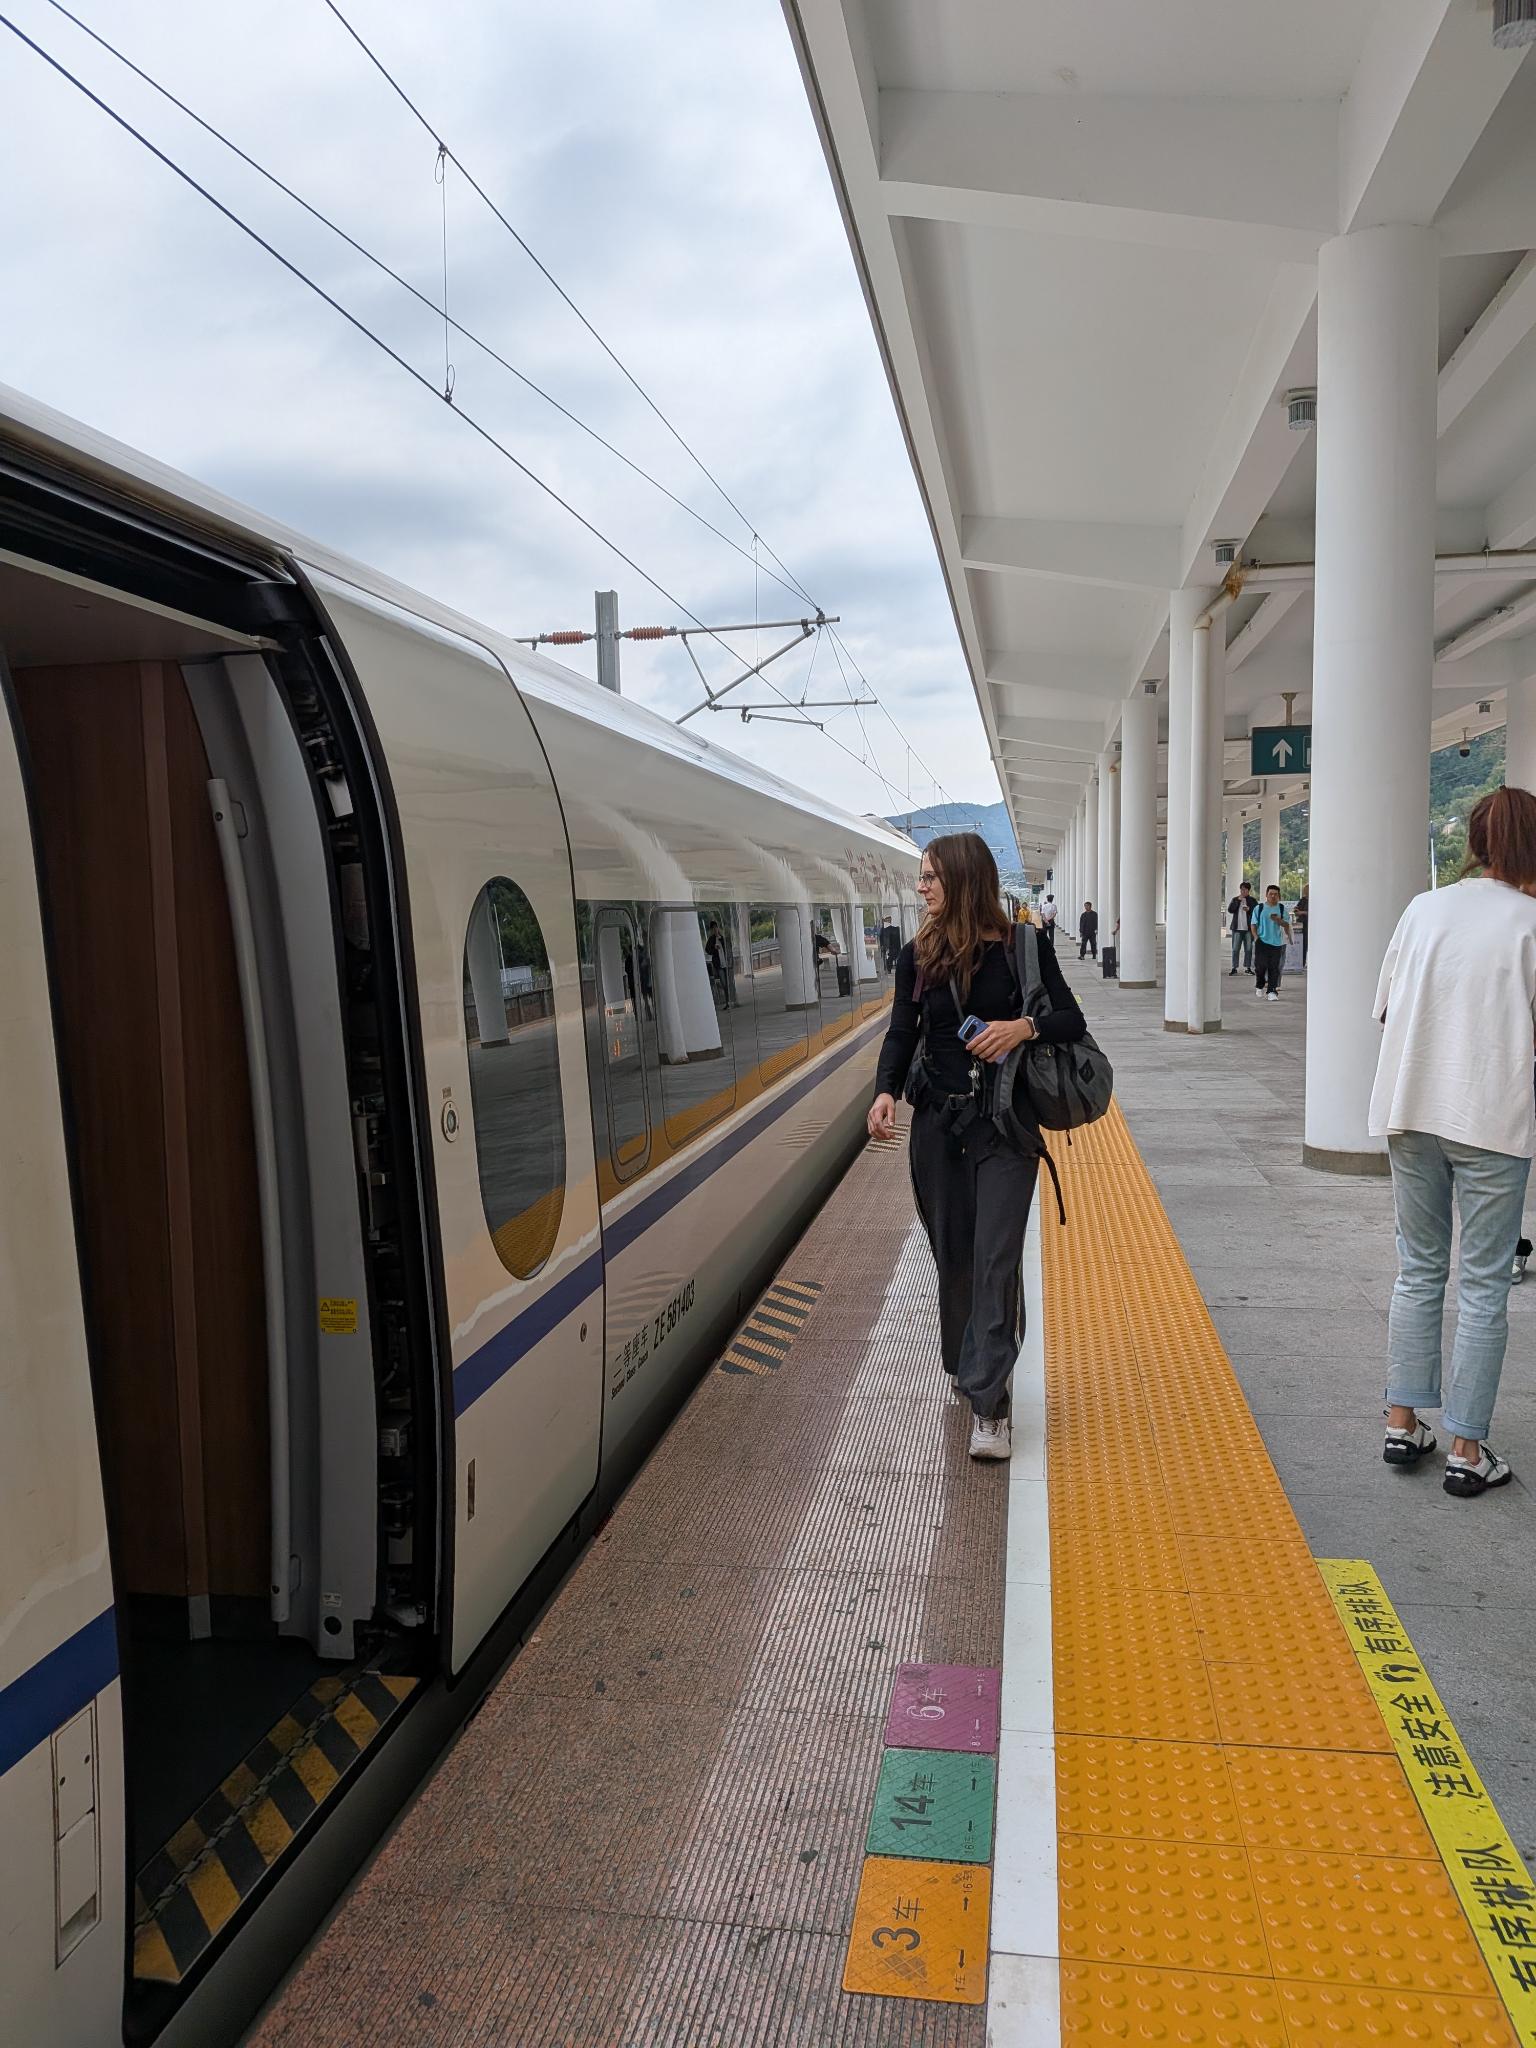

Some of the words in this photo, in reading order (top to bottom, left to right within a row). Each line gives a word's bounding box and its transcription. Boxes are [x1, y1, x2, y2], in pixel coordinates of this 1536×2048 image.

[654, 1311, 666, 1350] ZE
[667, 1279, 695, 1333] 581403
[613, 1324, 648, 1378] 二等座车
[1337, 1580, 1412, 1654] 有序排队
[906, 1686, 948, 1720] 6车
[1391, 1693, 1483, 1799] 注意安全
[889, 1772, 938, 1831] 14车
[871, 1896, 925, 1951] 3车
[954, 1973, 966, 1992] 1车
